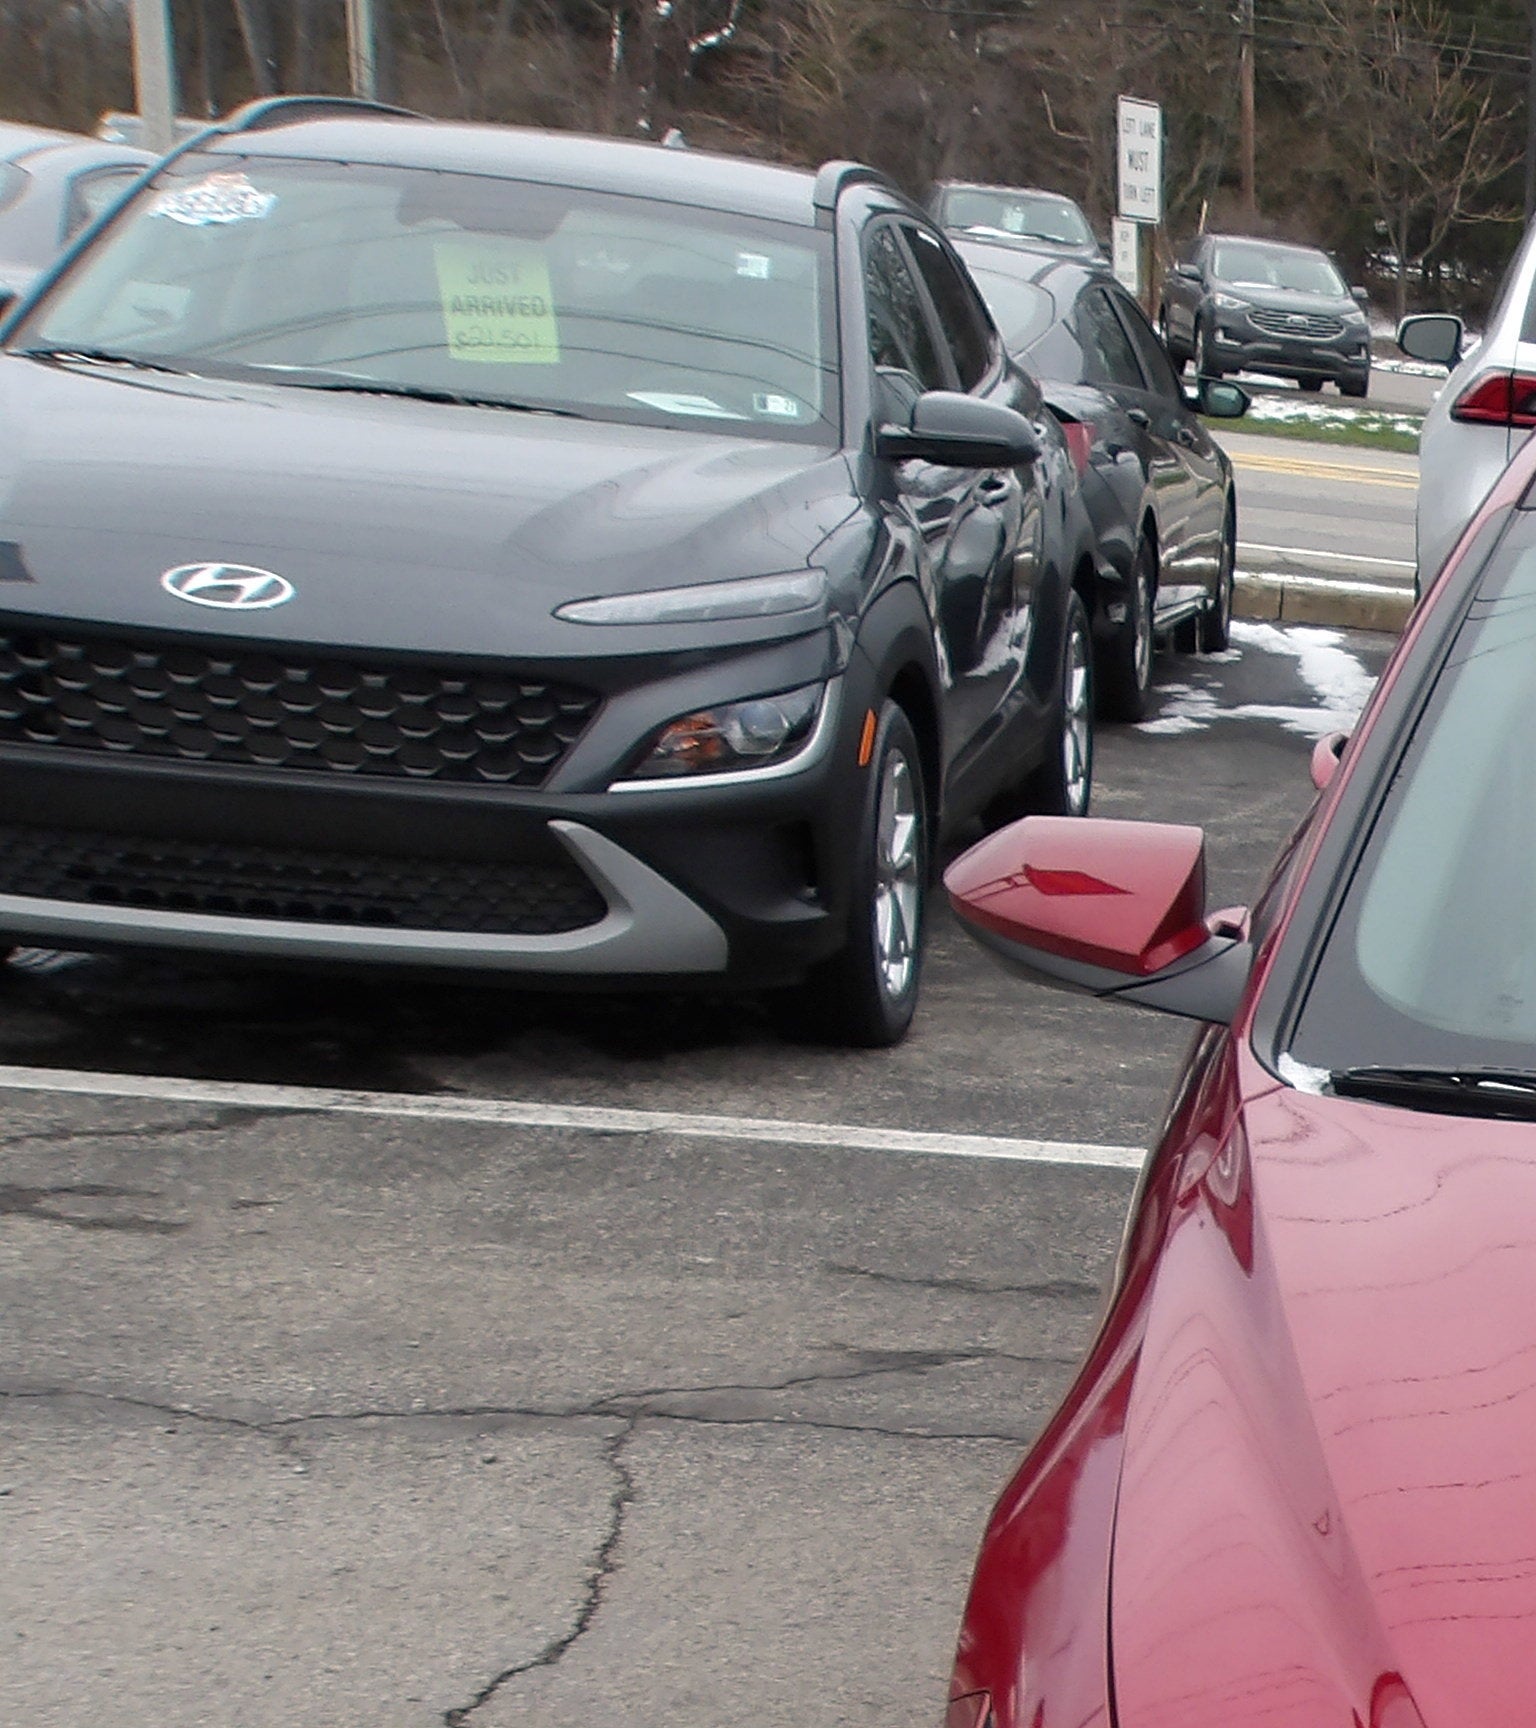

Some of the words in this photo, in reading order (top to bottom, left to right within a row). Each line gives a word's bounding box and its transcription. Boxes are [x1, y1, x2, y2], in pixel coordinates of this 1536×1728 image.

[1127, 149, 1149, 172] MUST
[466, 260, 524, 287] JUST
[451, 293, 547, 317] ARRIVED
